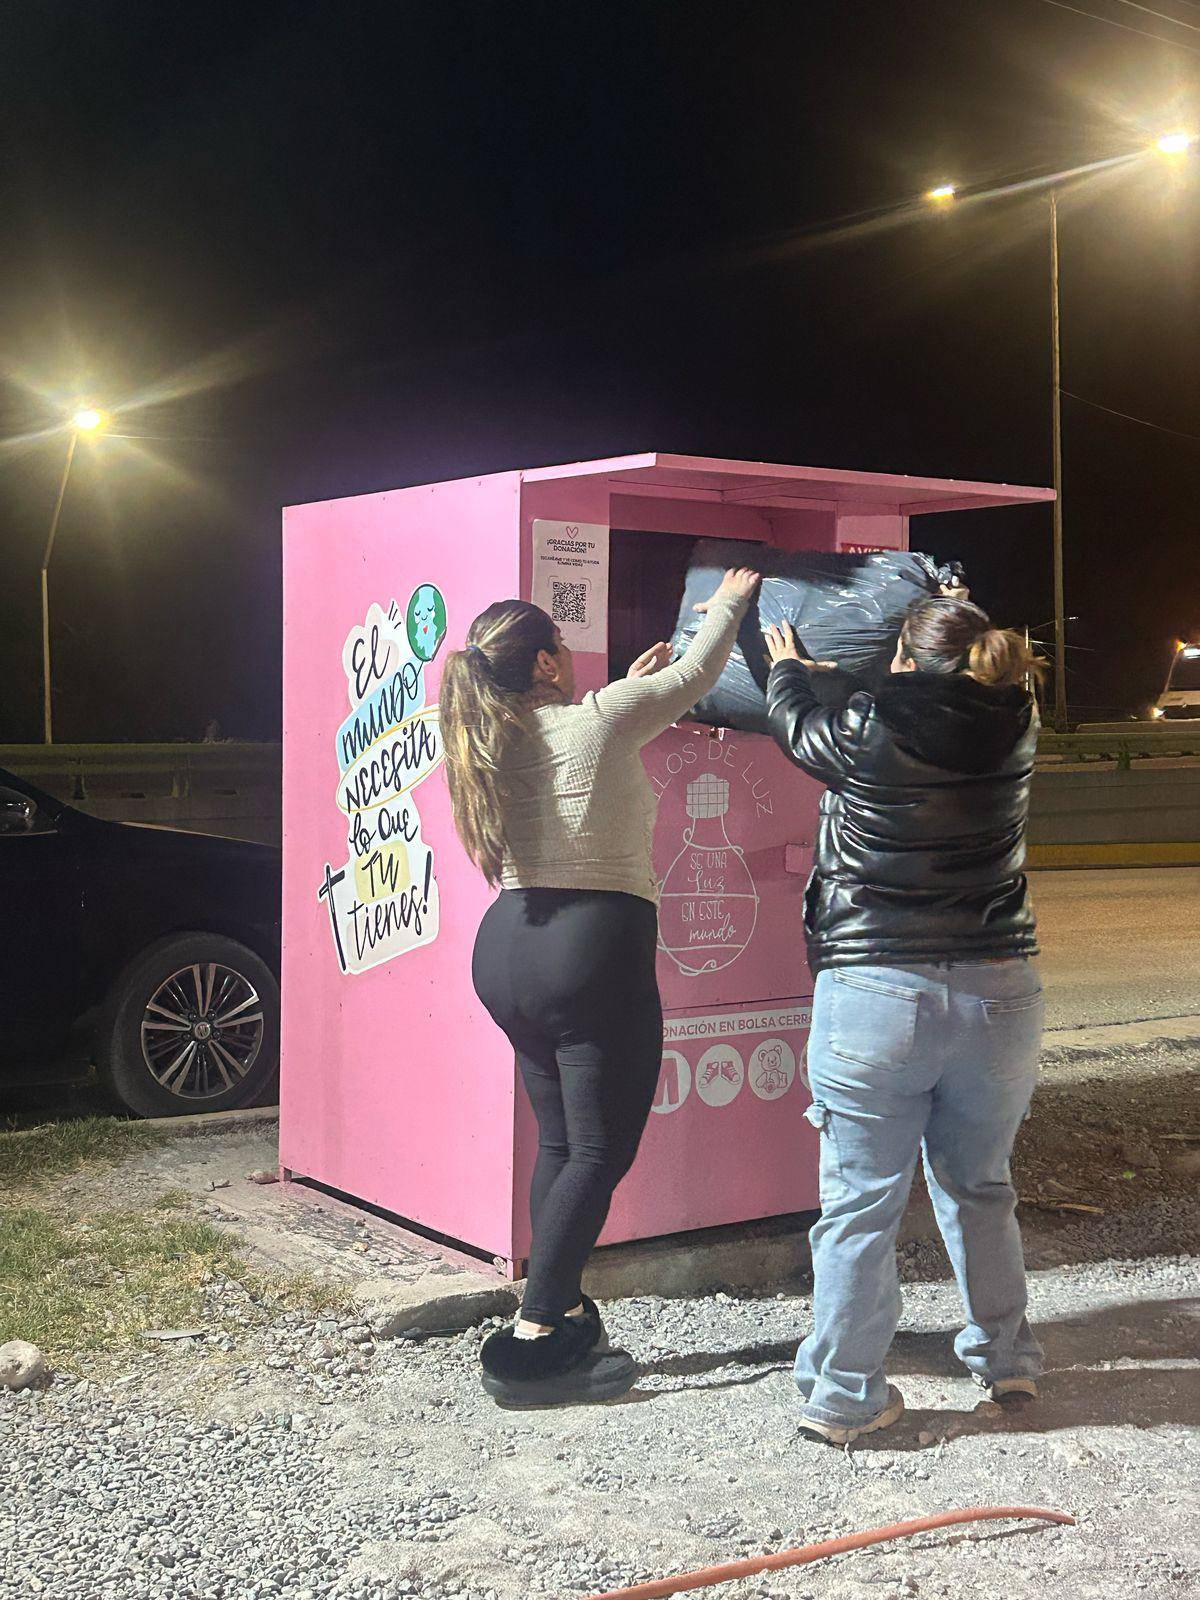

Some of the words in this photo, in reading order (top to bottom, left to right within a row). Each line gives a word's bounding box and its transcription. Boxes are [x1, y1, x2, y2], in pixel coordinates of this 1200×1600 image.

[352, 624, 391, 700] El
[652, 742, 698, 804] LOS
[708, 739, 739, 768] DE
[741, 761, 774, 819] LUZ
[707, 851, 728, 869] UNA
[681, 901, 696, 922] EN
[662, 1019, 716, 1038] ONACIÓN
[719, 1020, 735, 1033] EN
[738, 1017, 775, 1030] BOLSA
